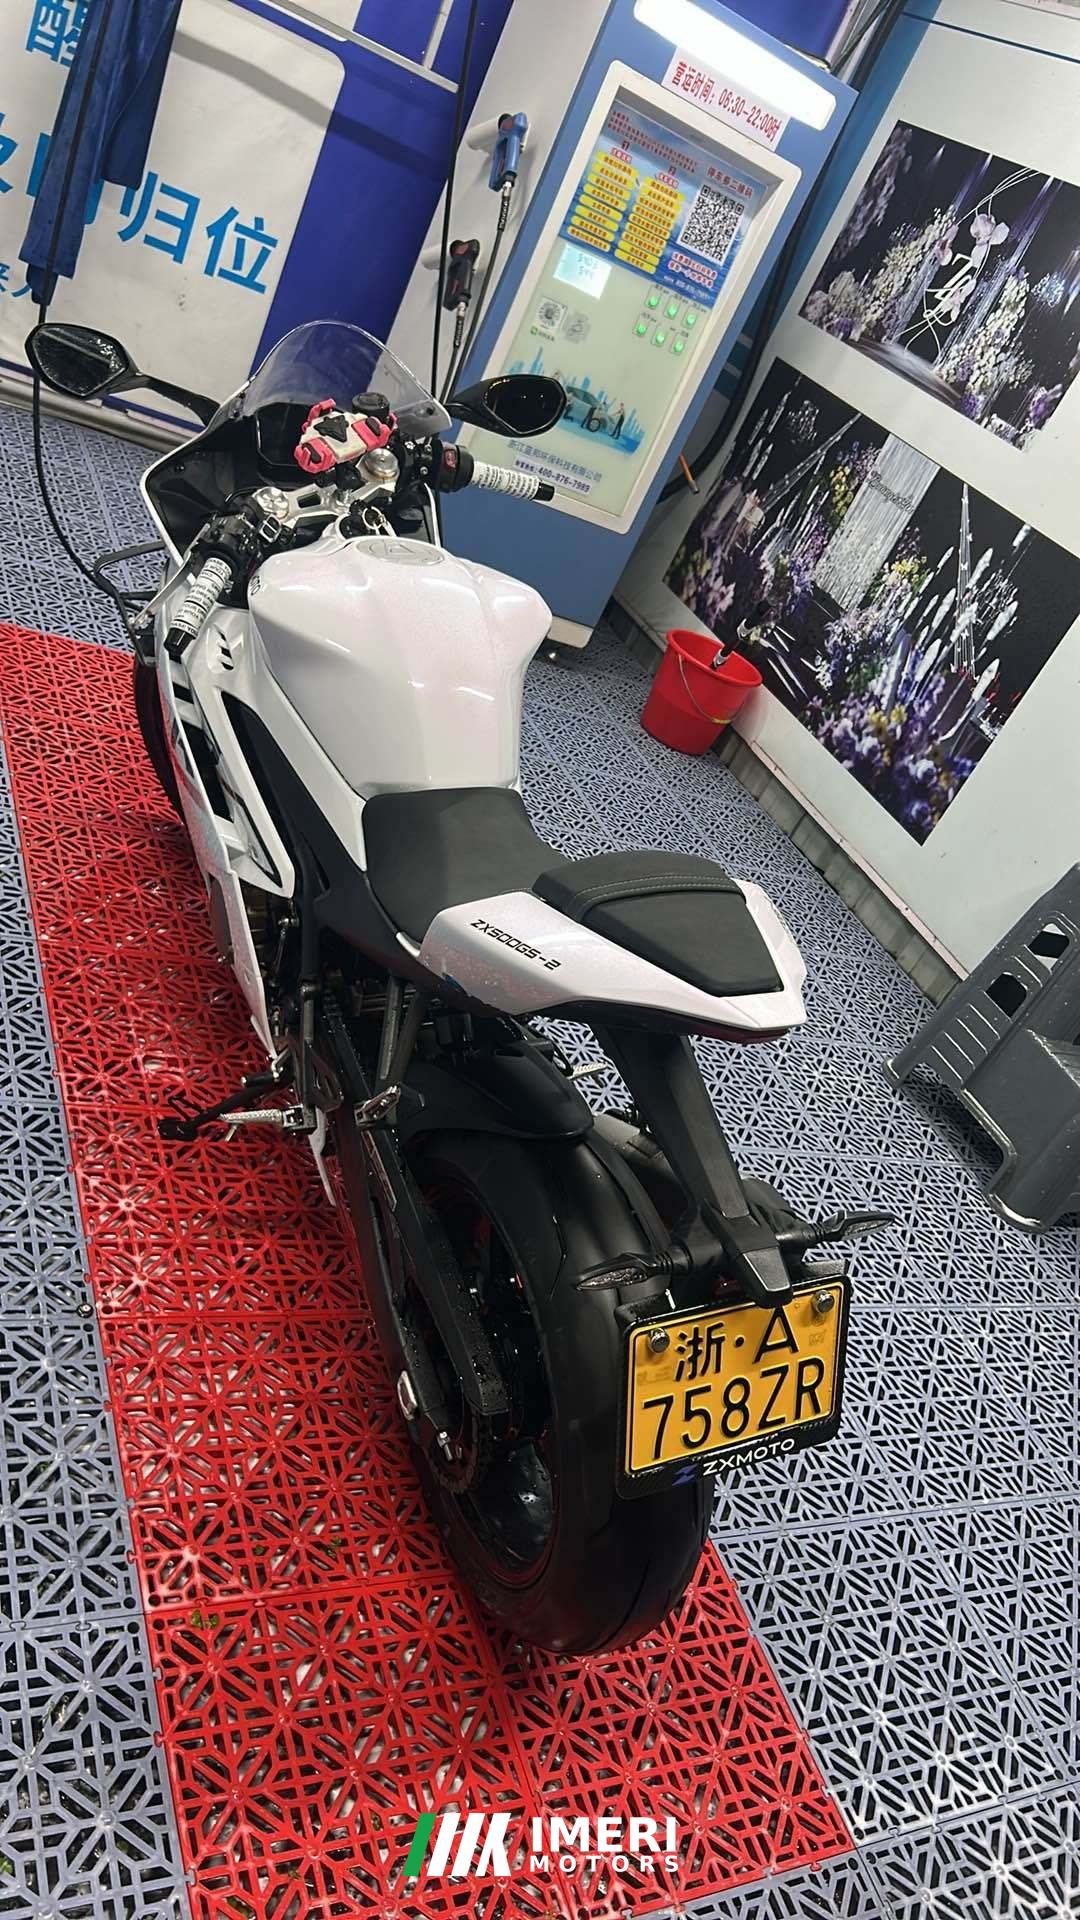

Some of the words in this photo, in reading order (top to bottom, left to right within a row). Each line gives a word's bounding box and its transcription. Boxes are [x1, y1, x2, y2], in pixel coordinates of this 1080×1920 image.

[470, 919, 562, 971] ZX500GS-2
[642, 1357, 825, 1460] 758ZR
[702, 1438, 795, 1476] ZXMOTO
